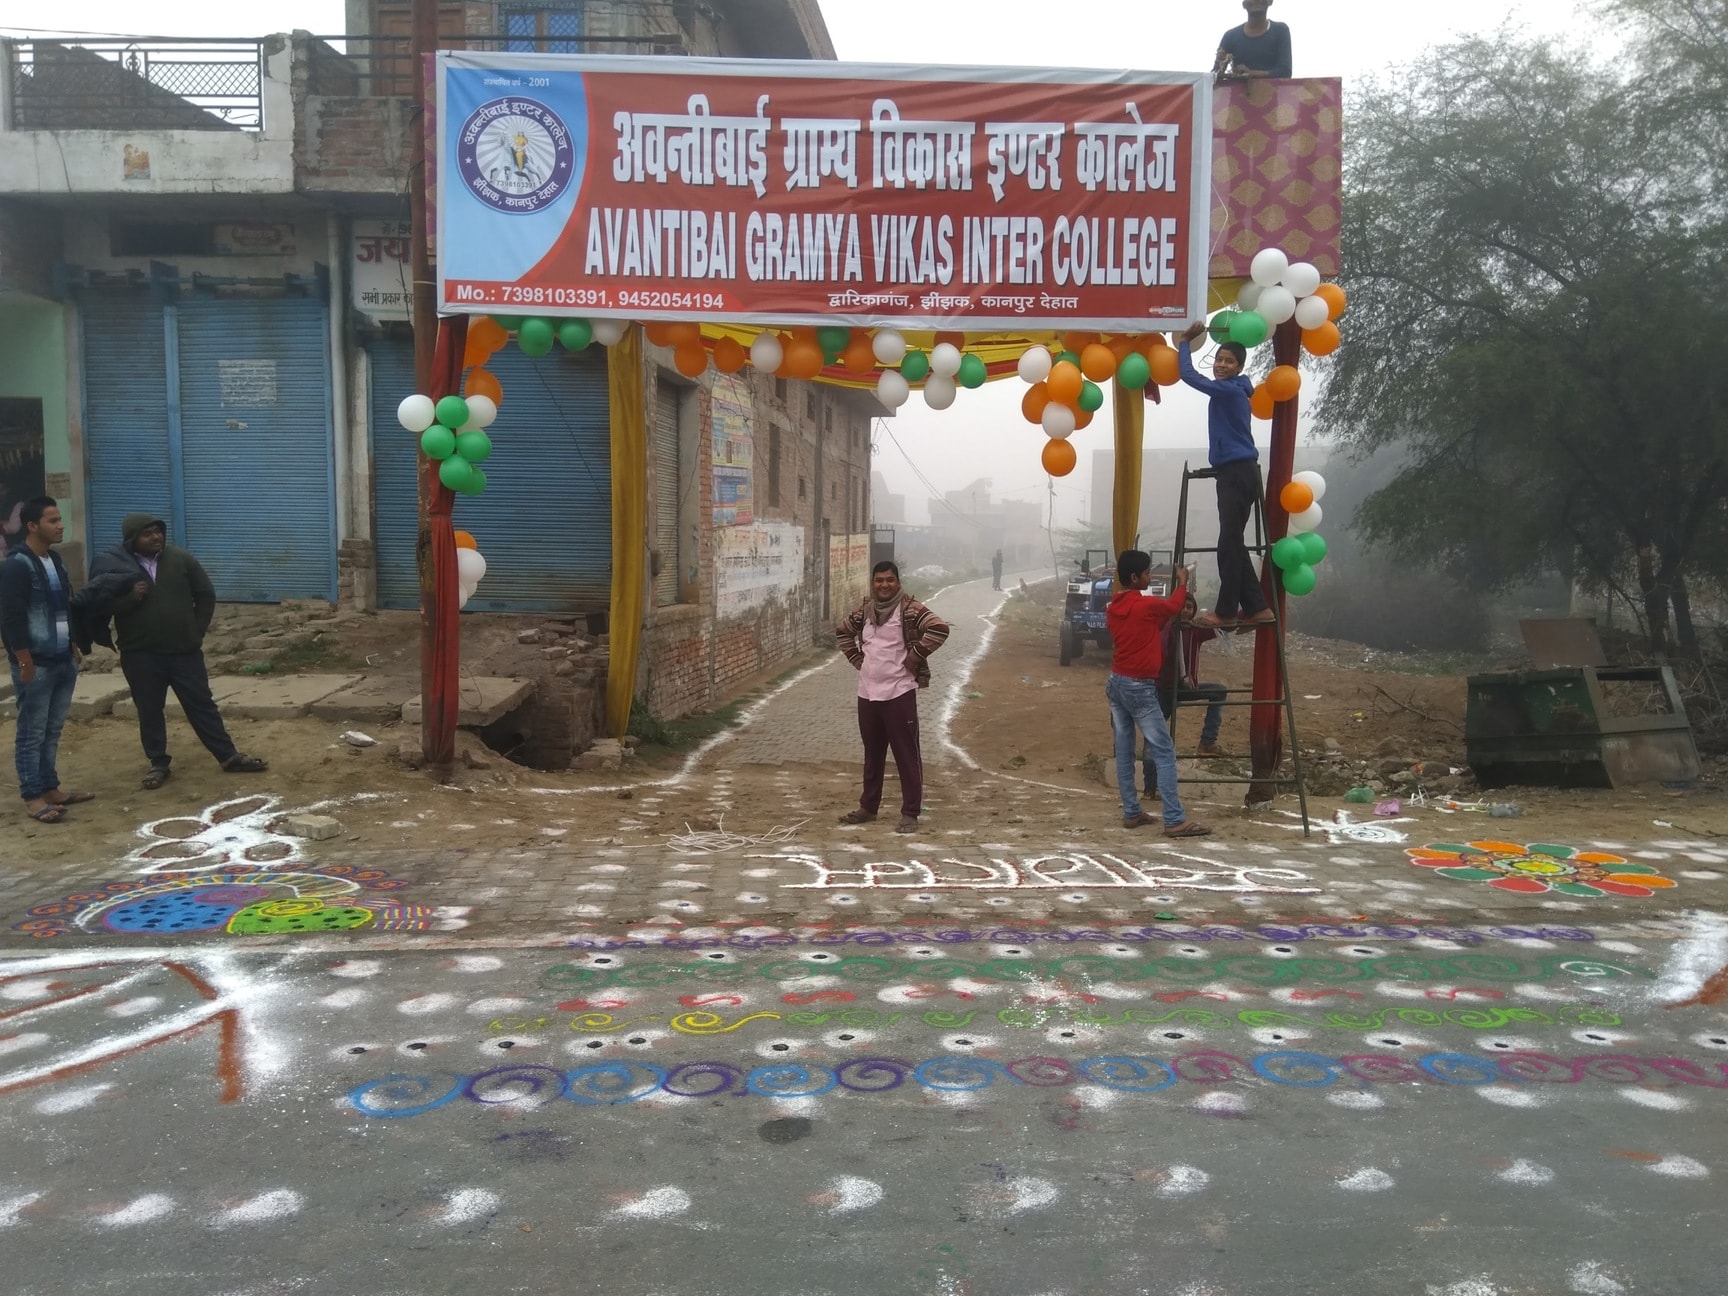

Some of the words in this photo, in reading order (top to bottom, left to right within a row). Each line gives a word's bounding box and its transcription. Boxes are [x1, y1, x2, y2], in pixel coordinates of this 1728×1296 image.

[528, 77, 550, 87] 2001
[464, 99, 511, 145] अवन्तीबाई
[511, 102, 543, 118] इण्टर
[543, 113, 568, 150] कालेज
[612, 93, 772, 199] अवन्तीबाई
[781, 117, 862, 192] ग्राम्य
[869, 98, 976, 191] विकास
[984, 121, 1065, 203] इण्टर
[1074, 101, 1180, 193] कालेज
[505, 194, 540, 210] कानपुर
[539, 181, 560, 199] देहात
[584, 206, 737, 280] AVANTIBAI
[745, 211, 863, 282] GRAMYA
[870, 213, 954, 285] VIKAS
[962, 215, 1044, 284] INTER
[1051, 214, 1177, 287] COLLEGE
[456, 285, 496, 300] Mo.:
[501, 286, 614, 307] 7398103391,
[618, 290, 724, 309] 9452054194
[828, 291, 914, 309] द्वारिकागंज,
[981, 294, 1036, 313] कानपुर
[1040, 291, 1079, 309] देहात
